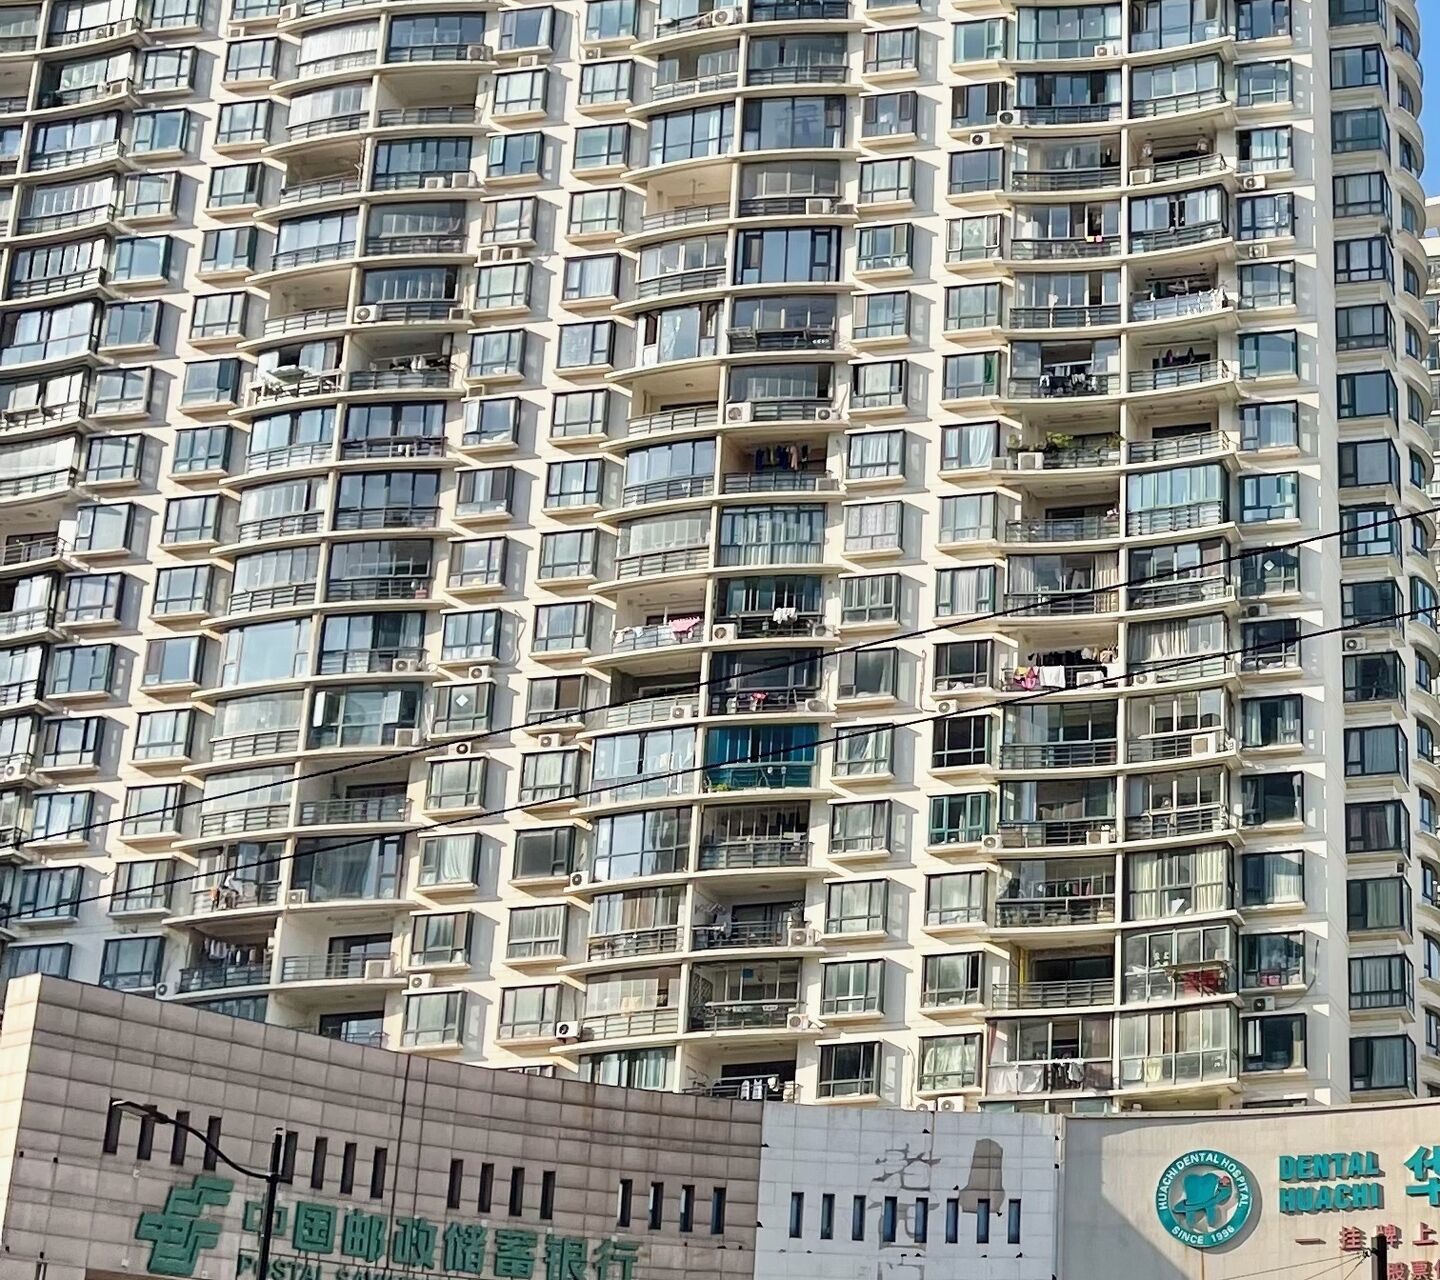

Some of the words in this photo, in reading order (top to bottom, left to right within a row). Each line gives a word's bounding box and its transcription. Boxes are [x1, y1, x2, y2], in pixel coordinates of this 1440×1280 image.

[1158, 1167, 1179, 1210] HUACHI
[1177, 1152, 1219, 1171] DENTAL
[1220, 1158, 1249, 1208] HOSPITAL
[1279, 1151, 1382, 1181] DENTAL
[1279, 1183, 1382, 1213] HUACHI
[1171, 1225, 1204, 1245] SINCE
[1210, 1225, 1235, 1243] 1996
